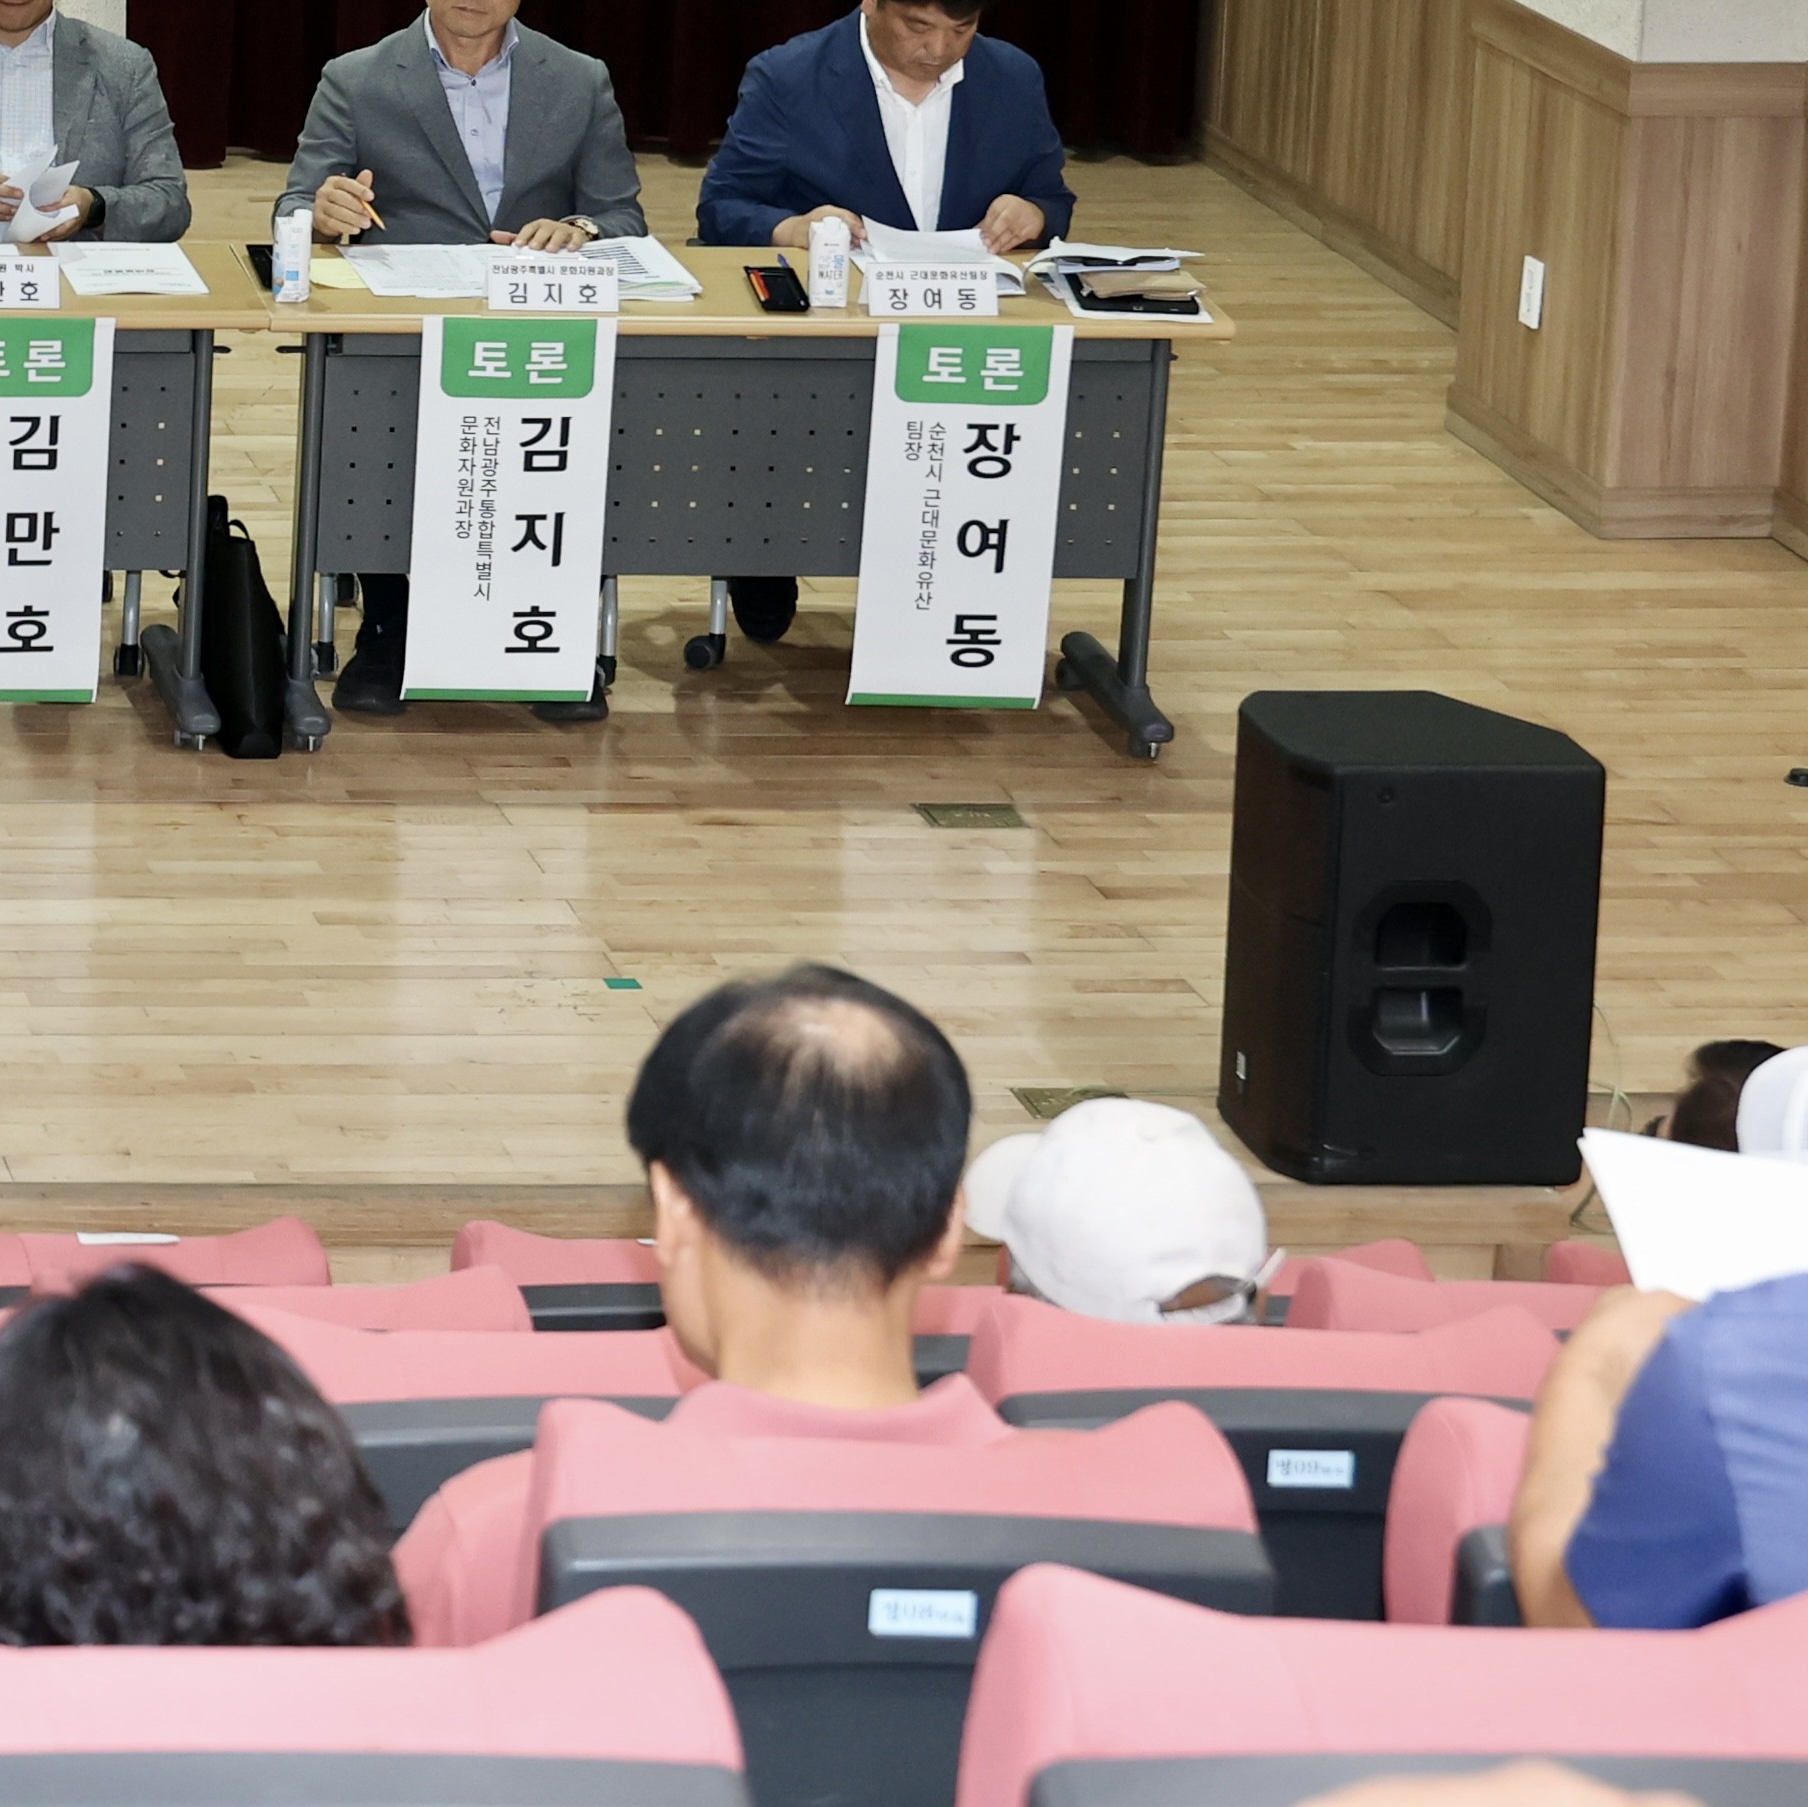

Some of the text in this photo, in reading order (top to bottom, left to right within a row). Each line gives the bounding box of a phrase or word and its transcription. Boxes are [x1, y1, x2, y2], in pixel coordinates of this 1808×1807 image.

[15, 264, 34, 273] 박사
[492, 265, 554, 274] 전남광주특별시
[818, 270, 843, 280] WATER
[876, 271, 904, 280] 순천시
[468, 342, 567, 383] 토론
[922, 347, 1024, 390] 토론
[904, 421, 923, 461] 팀장
[455, 416, 479, 539] 문화자원과장
[474, 416, 501, 601] 전남광주통합특별시
[914, 422, 947, 610] 순천시 근대문화유산
